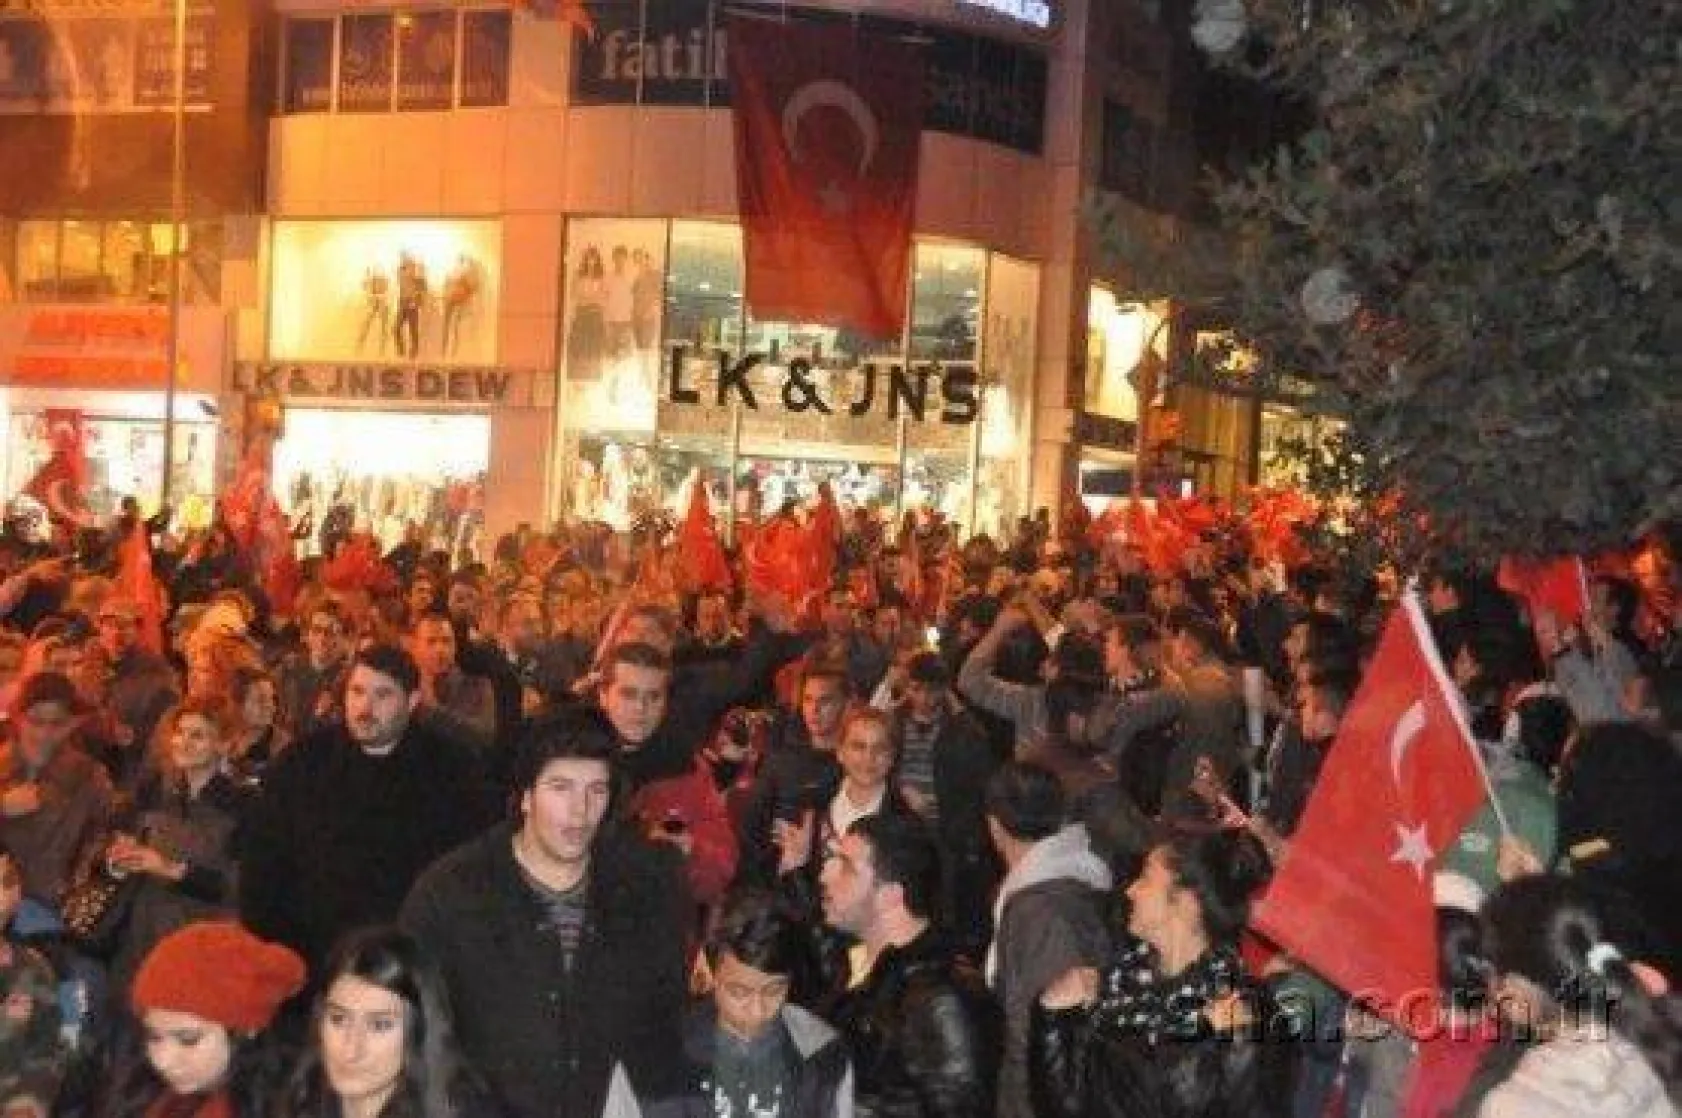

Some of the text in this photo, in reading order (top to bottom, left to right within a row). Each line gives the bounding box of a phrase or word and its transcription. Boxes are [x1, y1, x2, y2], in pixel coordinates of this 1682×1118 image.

[415, 369, 510, 401] DEW
[671, 345, 980, 425] LK & JNS
